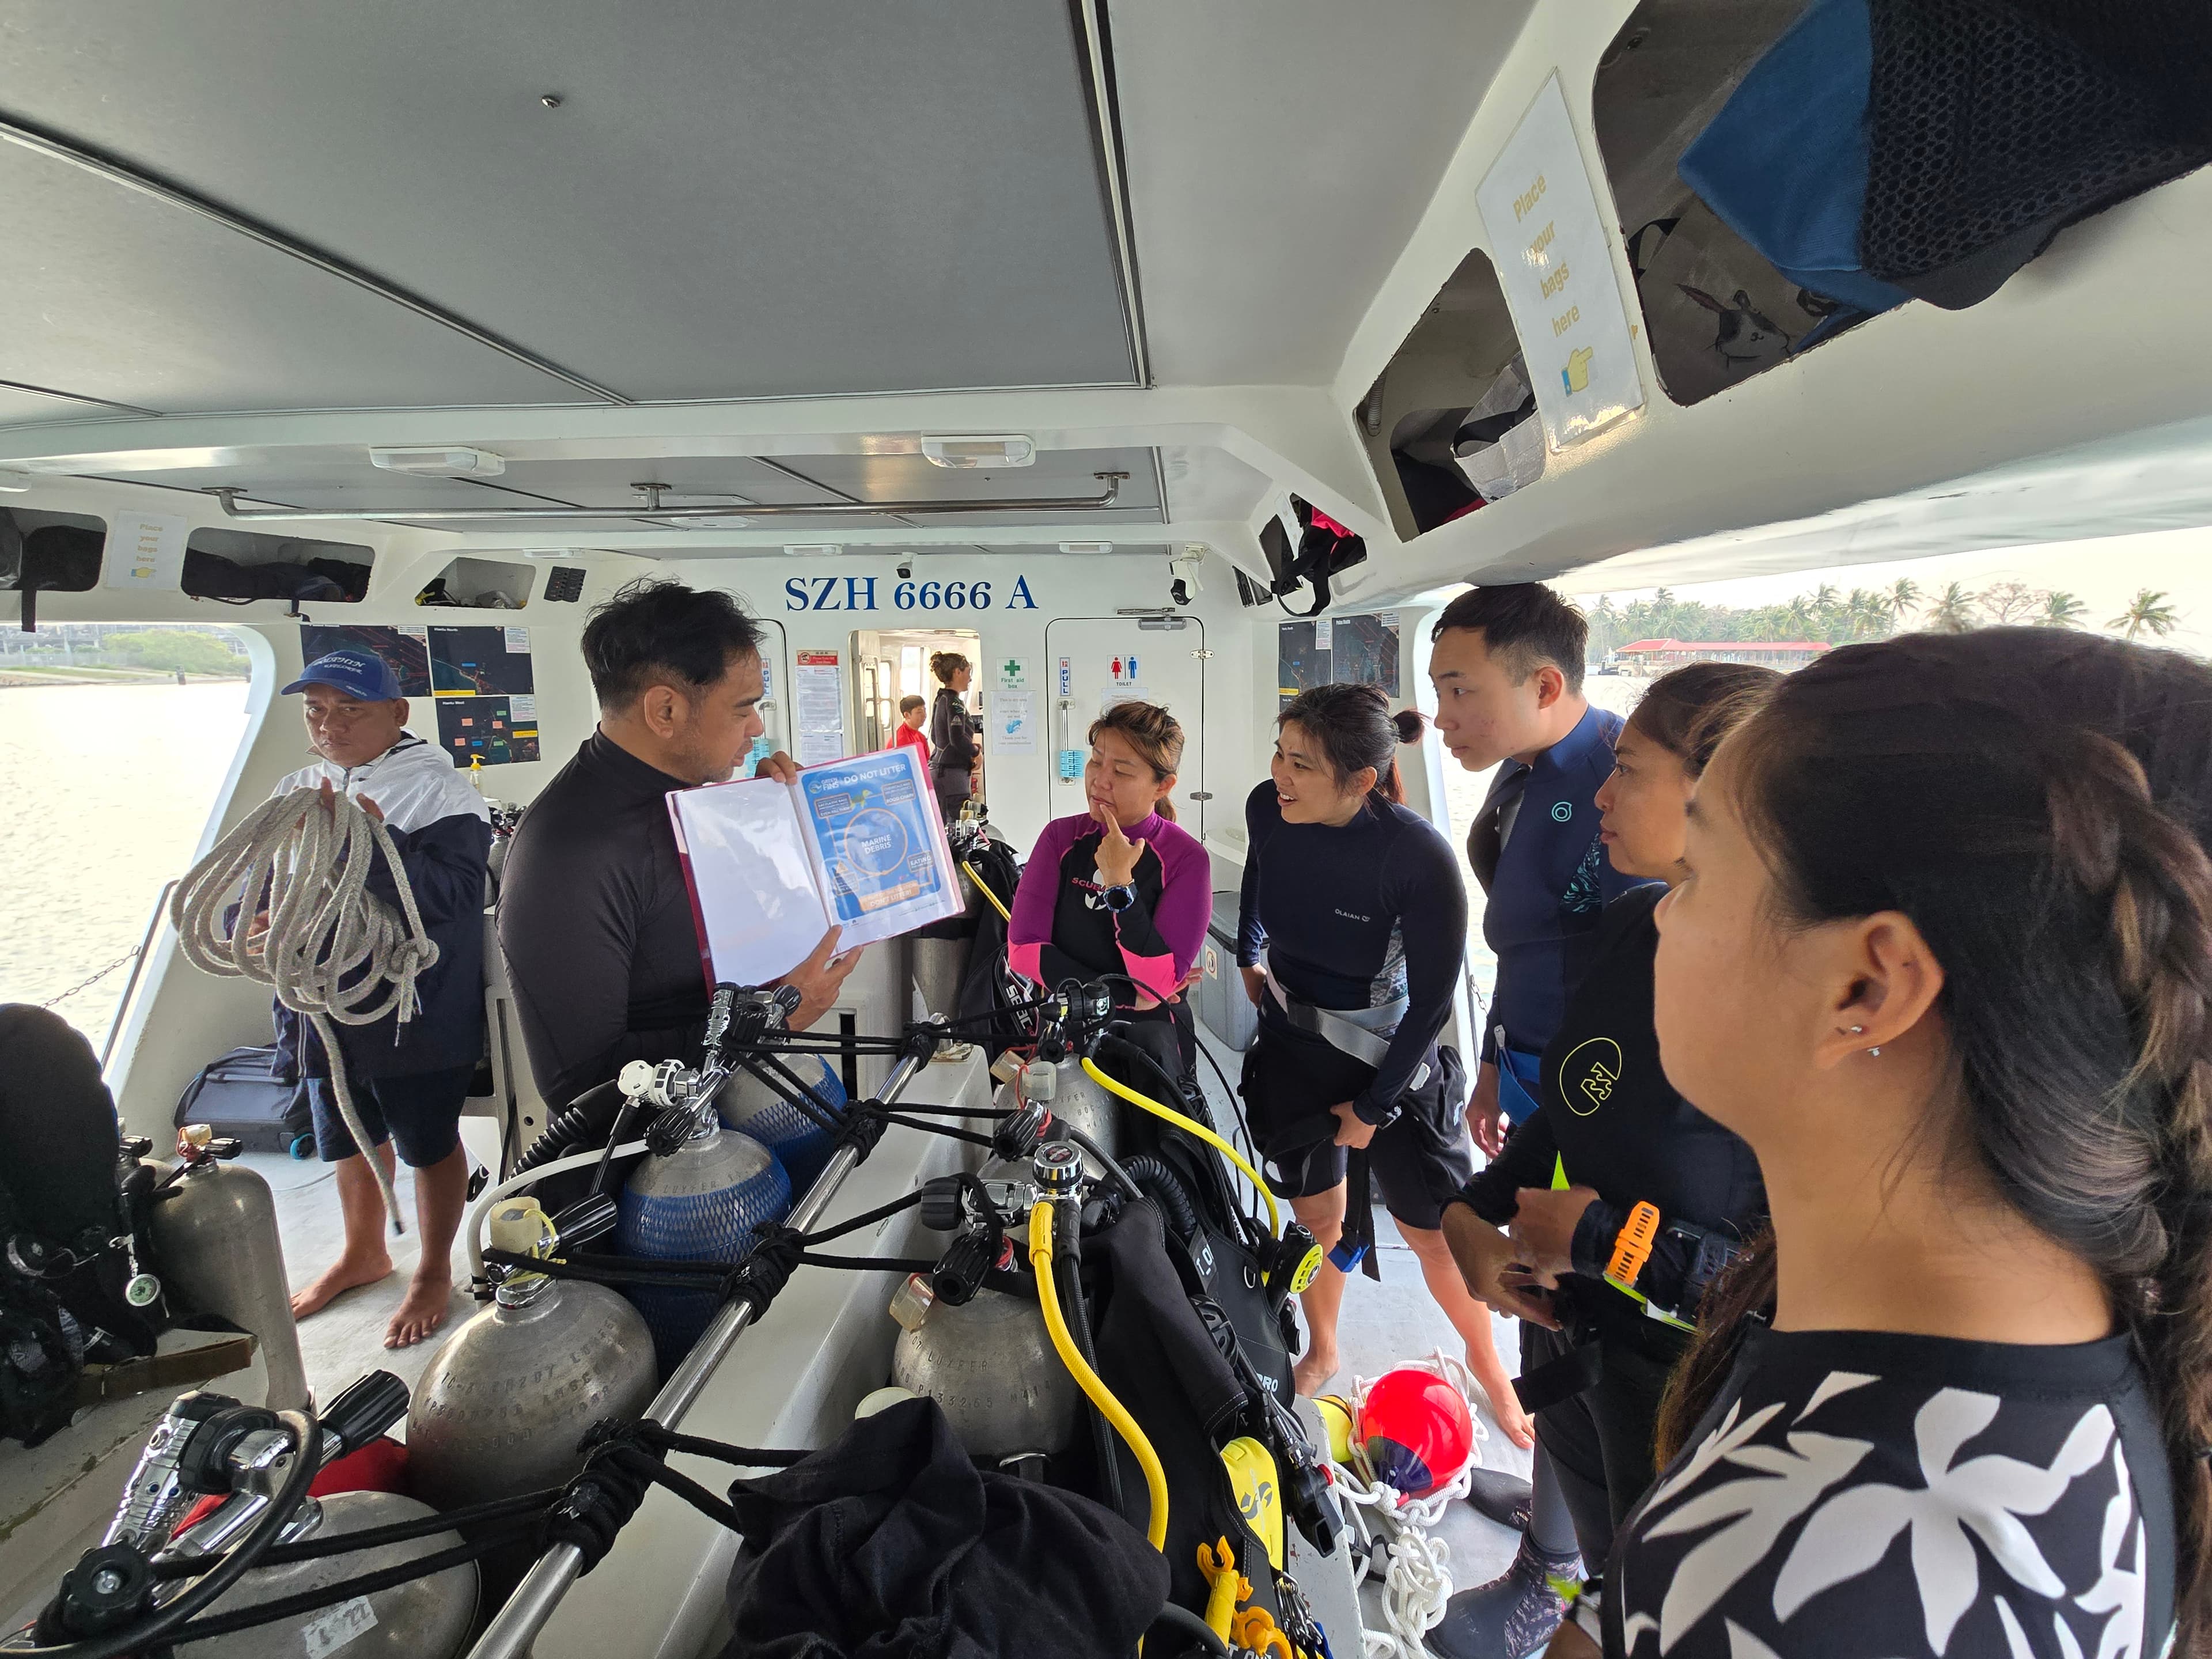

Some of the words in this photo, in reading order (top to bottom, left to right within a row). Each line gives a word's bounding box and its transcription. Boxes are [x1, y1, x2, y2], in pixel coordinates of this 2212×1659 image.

[1513, 174, 1547, 223] Place
[1540, 262, 1569, 300] bags
[1552, 305, 1580, 338] here
[138, 545, 158, 553] bags
[785, 577, 880, 611] SZH
[894, 581, 991, 610] 6666
[1005, 574, 1039, 609] A
[843, 775, 858, 785] DO
[860, 770, 879, 782] NOT
[880, 763, 907, 776] LITTER
[823, 781, 840, 791] FINS
[861, 834, 892, 847] MARINE
[864, 842, 892, 854] DEBRIS
[910, 855, 932, 866] EATING
[870, 896, 890, 906] DON'T
[1335, 908, 1360, 920] OLAIAN
